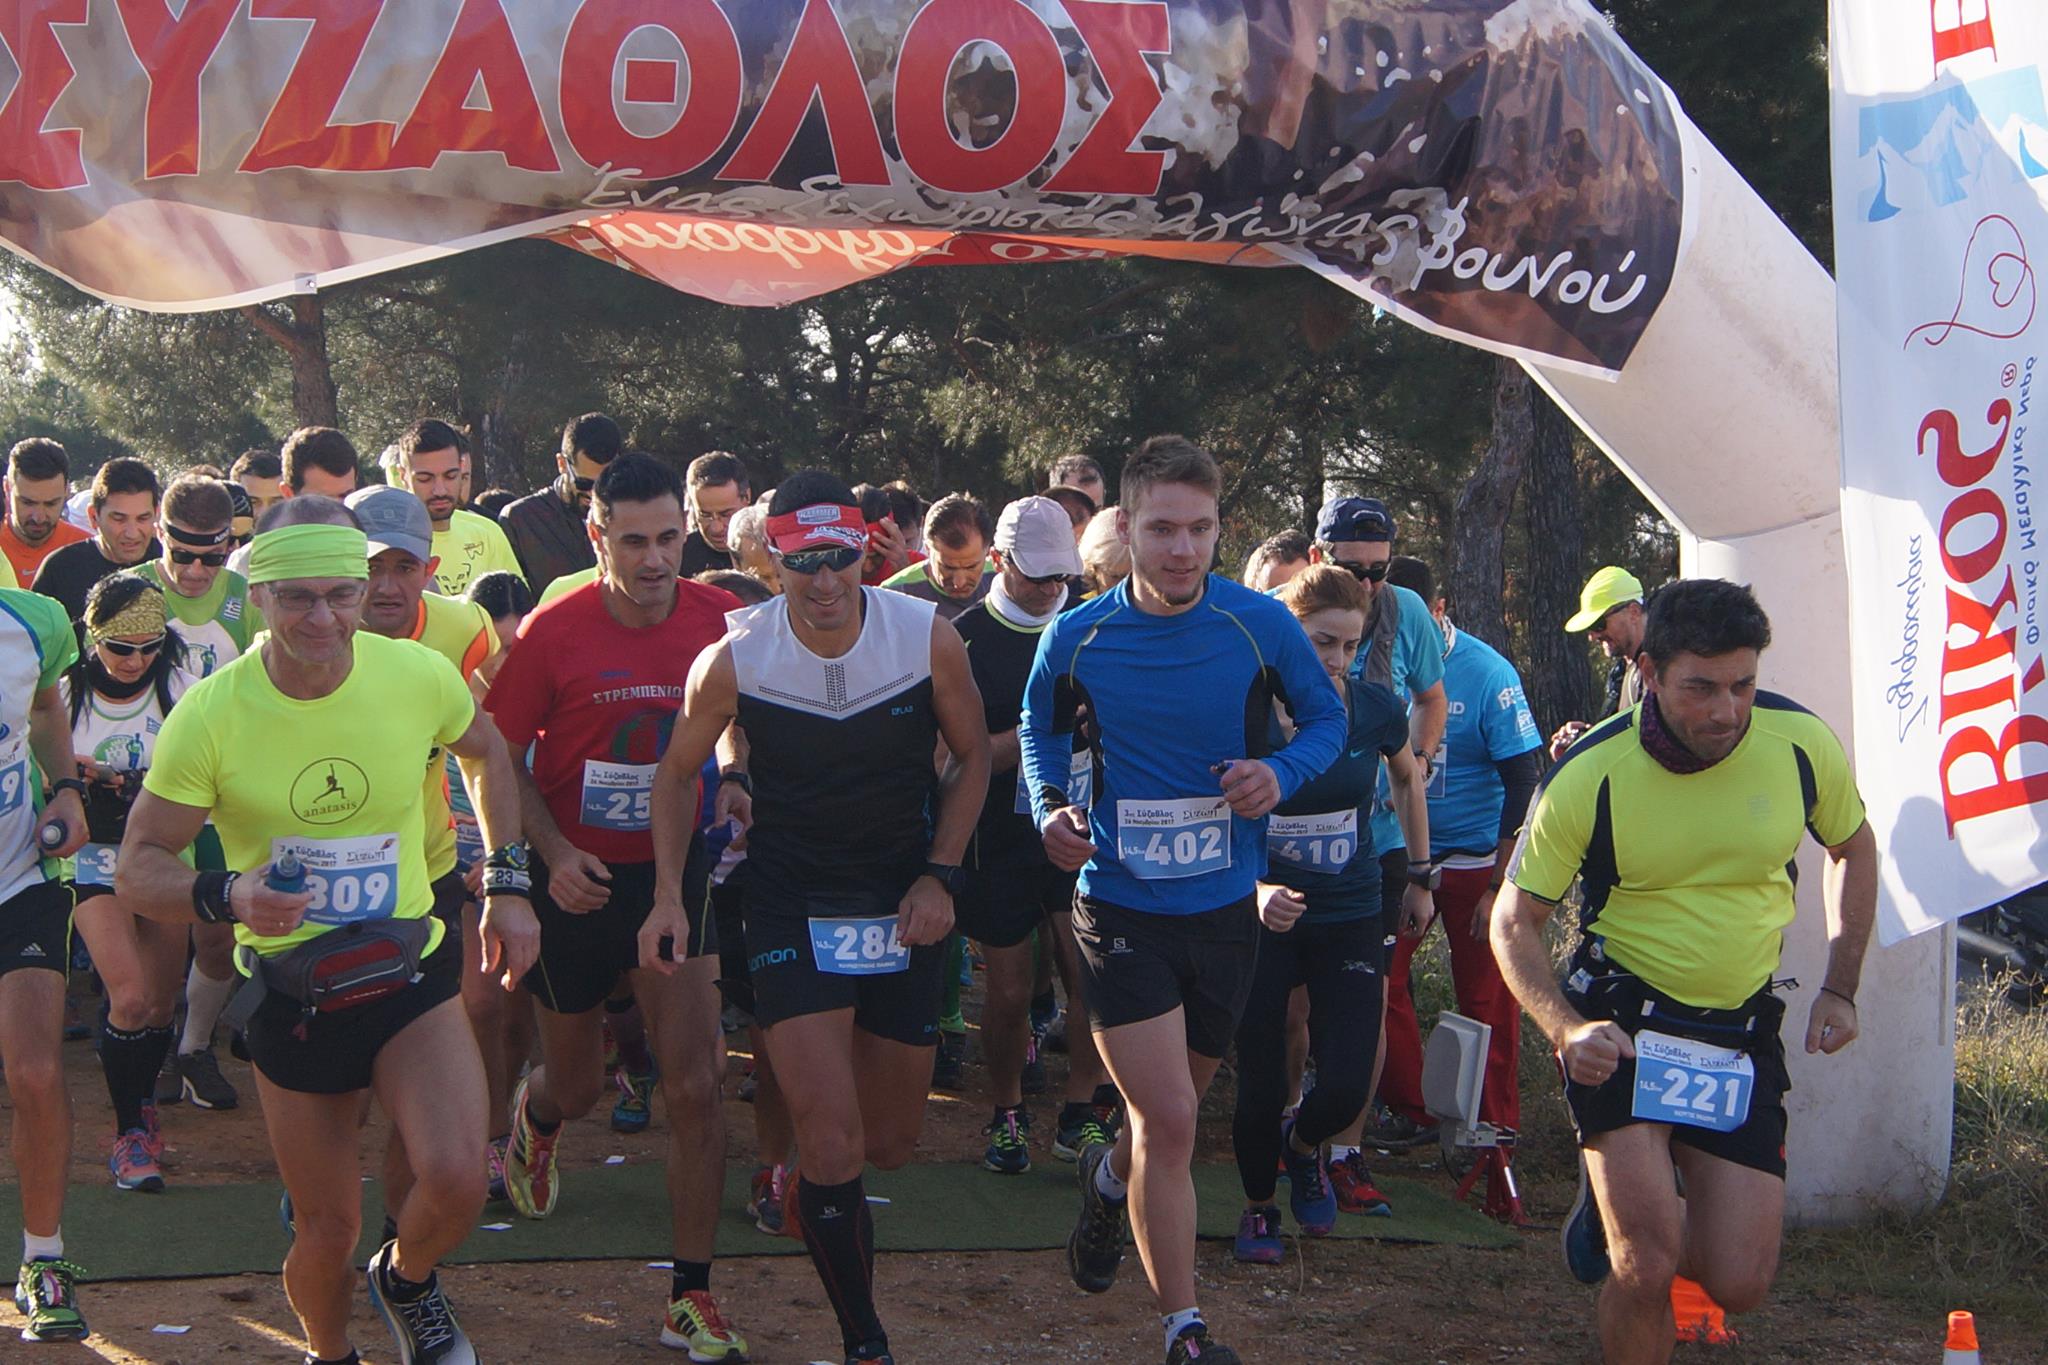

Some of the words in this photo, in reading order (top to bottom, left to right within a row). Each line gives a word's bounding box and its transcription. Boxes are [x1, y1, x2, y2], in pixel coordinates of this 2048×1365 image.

[1409, 196, 1647, 314] βουνού
[592, 685, 685, 705] ΣΤΡΕΜΠΕΝΙΩ
[606, 792, 651, 820] 25
[1145, 826, 1222, 865] 402
[1280, 838, 1350, 864] 410
[305, 872, 390, 913] 309
[495, 869, 513, 884] 23
[833, 923, 906, 961] 284
[1661, 1067, 1741, 1117] 221
